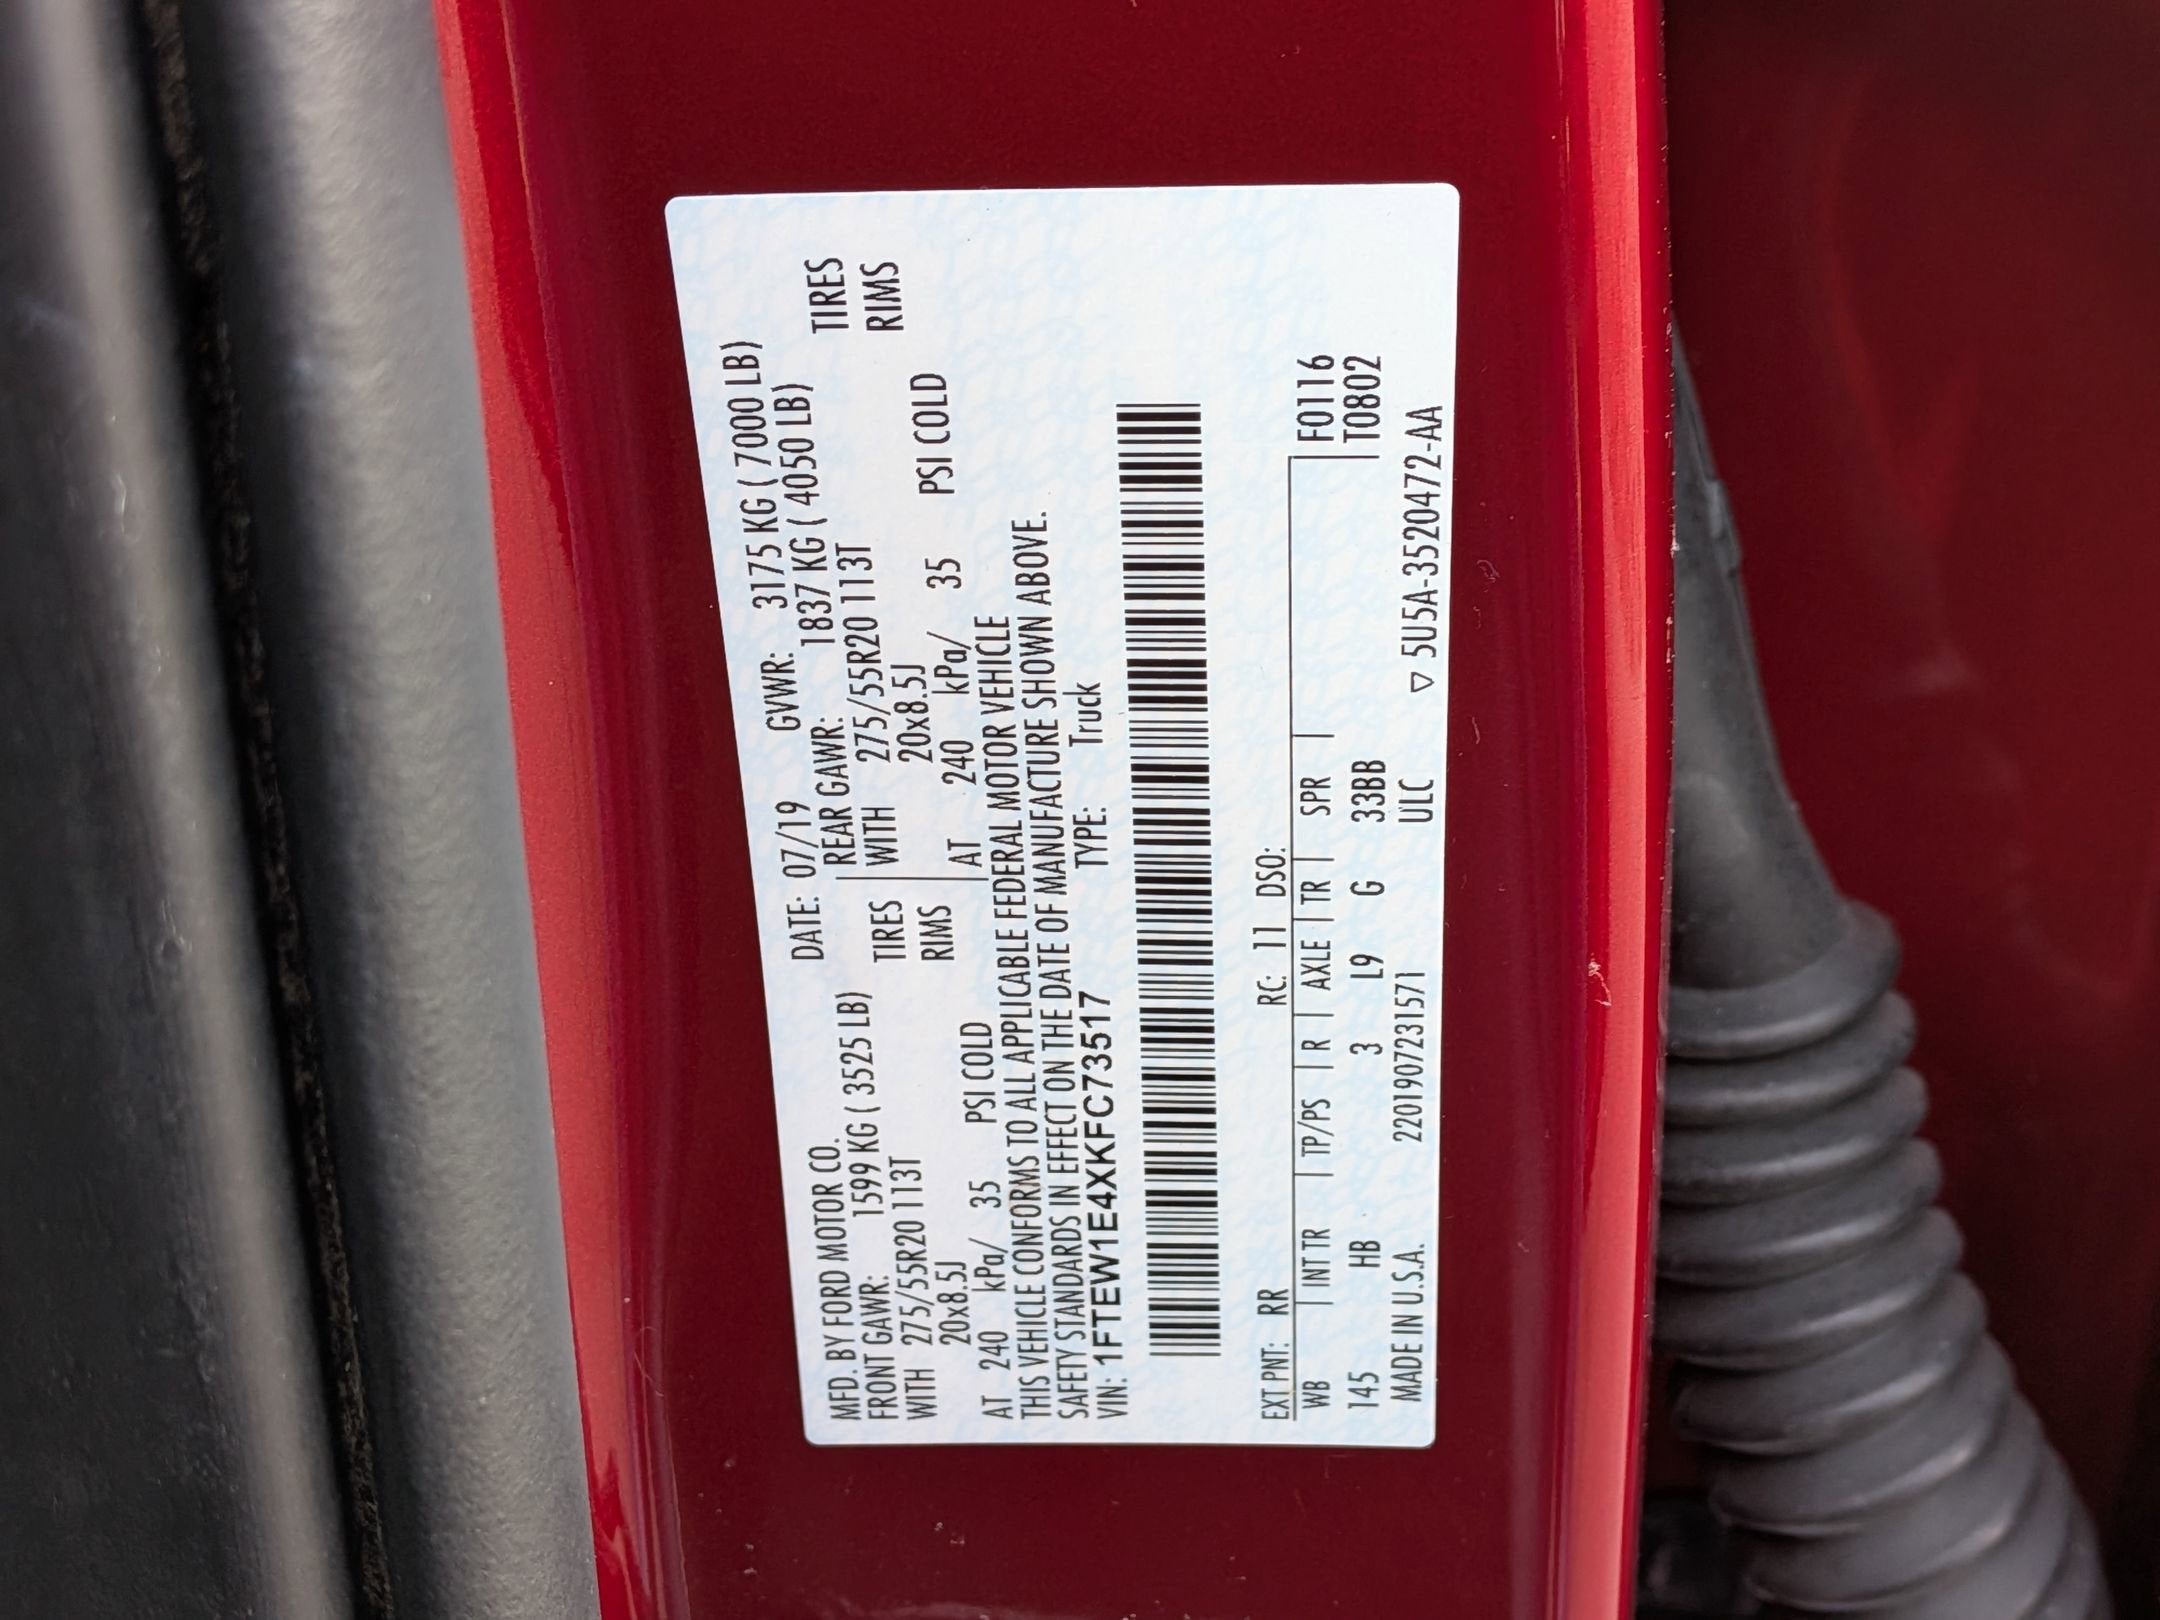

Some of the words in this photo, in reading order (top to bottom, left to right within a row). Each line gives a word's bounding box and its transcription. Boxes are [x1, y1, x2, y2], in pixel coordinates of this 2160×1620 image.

[803, 257, 850, 334] TIRES
[858, 261, 905, 332] RIMS
[718, 340, 763, 385] LB)
[769, 382, 814, 426] LB)
[909, 373, 951, 445] COLD
[1295, 354, 1335, 442] F0116
[1341, 355, 1382, 444] T0802
[915, 456, 955, 495] PSI
[739, 498, 779, 533] KG
[1400, 405, 1443, 658] 5U5A-3520472-AA
[744, 543, 788, 610] 3175
[787, 536, 828, 572] KG
[834, 542, 876, 605] 113T
[924, 557, 962, 589] 35
[1010, 511, 1052, 607] ABOVE.
[793, 582, 836, 647] 1837
[841, 616, 892, 763] 275/55R20
[925, 631, 972, 695] kPa/
[973, 615, 1015, 716] VEHICLE
[1016, 615, 1057, 710] SHOWN
[759, 652, 802, 731] GVWR:
[889, 664, 934, 764] 20x8.5J
[1061, 681, 1103, 748] Truck
[809, 717, 850, 797] GAWR:
[938, 739, 977, 786] 240
[981, 723, 1022, 811] MOTOR
[1023, 718, 1068, 896] MANUFACTURE
[1299, 776, 1331, 816] SPR
[1350, 759, 1386, 823] 33BB
[1397, 778, 1434, 823] ULC
[774, 800, 819, 878] 07/19
[817, 805, 857, 865] REAR
[859, 806, 900, 867] WITH
[946, 837, 983, 868] AT
[1071, 807, 1109, 870] TYPE:
[987, 819, 1028, 919] FEDERAL
[1254, 847, 1287, 897] DSO:
[1299, 880, 1331, 906] TR
[1348, 880, 1385, 896] G
[785, 896, 825, 960] DATE:
[867, 900, 907, 964] TIRES
[916, 905, 955, 961] RIMS
[1033, 903, 1069, 933] OF
[1251, 926, 1287, 950] 11
[1036, 942, 1072, 999] DATE
[1255, 975, 1287, 1006] RC:
[1299, 939, 1331, 991] AXLE
[1348, 953, 1384, 979] L9
[834, 991, 873, 1027] LB)
[994, 928, 1035, 1065] APPLICABLE
[958, 1021, 995, 1081] COLD
[1039, 1008, 1074, 1052] THE
[1300, 1038, 1331, 1051] R
[1348, 1042, 1383, 1055] 3
[1392, 971, 1425, 1143] 2201907231571
[1002, 1071, 1038, 1112] ALL
[1041, 1060, 1076, 1092] ON
[962, 1090, 997, 1123] PSI
[1004, 1119, 1039, 1148] TO
[1297, 1098, 1334, 1158] TP/PS
[806, 1138, 842, 1173] CO.
[844, 1122, 880, 1153] KG
[1043, 1100, 1079, 1174] EFFECT
[847, 1162, 885, 1218] 1599
[887, 1155, 924, 1210] 113T
[967, 1180, 1002, 1208] 35
[1047, 1184, 1081, 1206] IN
[1077, 990, 1123, 1366] 1FTEW1E4XKFC73517
[811, 1182, 849, 1262] MOTOR
[1005, 1155, 1045, 1276] CONFORMS
[1300, 1228, 1331, 1251] TR
[967, 1237, 1009, 1292] kPa/
[1047, 1215, 1086, 1341] STANDARDS
[1300, 1256, 1331, 1287] INT
[1348, 1239, 1381, 1268] HB
[1390, 1243, 1425, 1305] U.S.A.
[818, 1269, 854, 1326] FORD
[857, 1275, 893, 1345] GAWR:
[892, 1219, 935, 1346] 275/55R20
[933, 1261, 972, 1346] 20x8.5J
[1256, 1288, 1289, 1316] RR
[823, 1334, 857, 1361] BY
[976, 1330, 1011, 1371] 240
[1013, 1284, 1049, 1368] VEHICLE
[1390, 1314, 1423, 1334] IN
[863, 1353, 899, 1420] FRONT
[1054, 1347, 1089, 1419] SAFETY
[1260, 1342, 1289, 1381] PNT:
[1389, 1342, 1422, 1402] MADE
[827, 1369, 861, 1420] MFD.
[903, 1368, 938, 1420] WITH
[980, 1394, 1014, 1420] AT
[1017, 1375, 1051, 1420] THIS
[1095, 1377, 1128, 1419] VIN:
[1260, 1387, 1290, 1420] EXT
[1301, 1380, 1331, 1409] WB
[1347, 1371, 1380, 1409] 145
